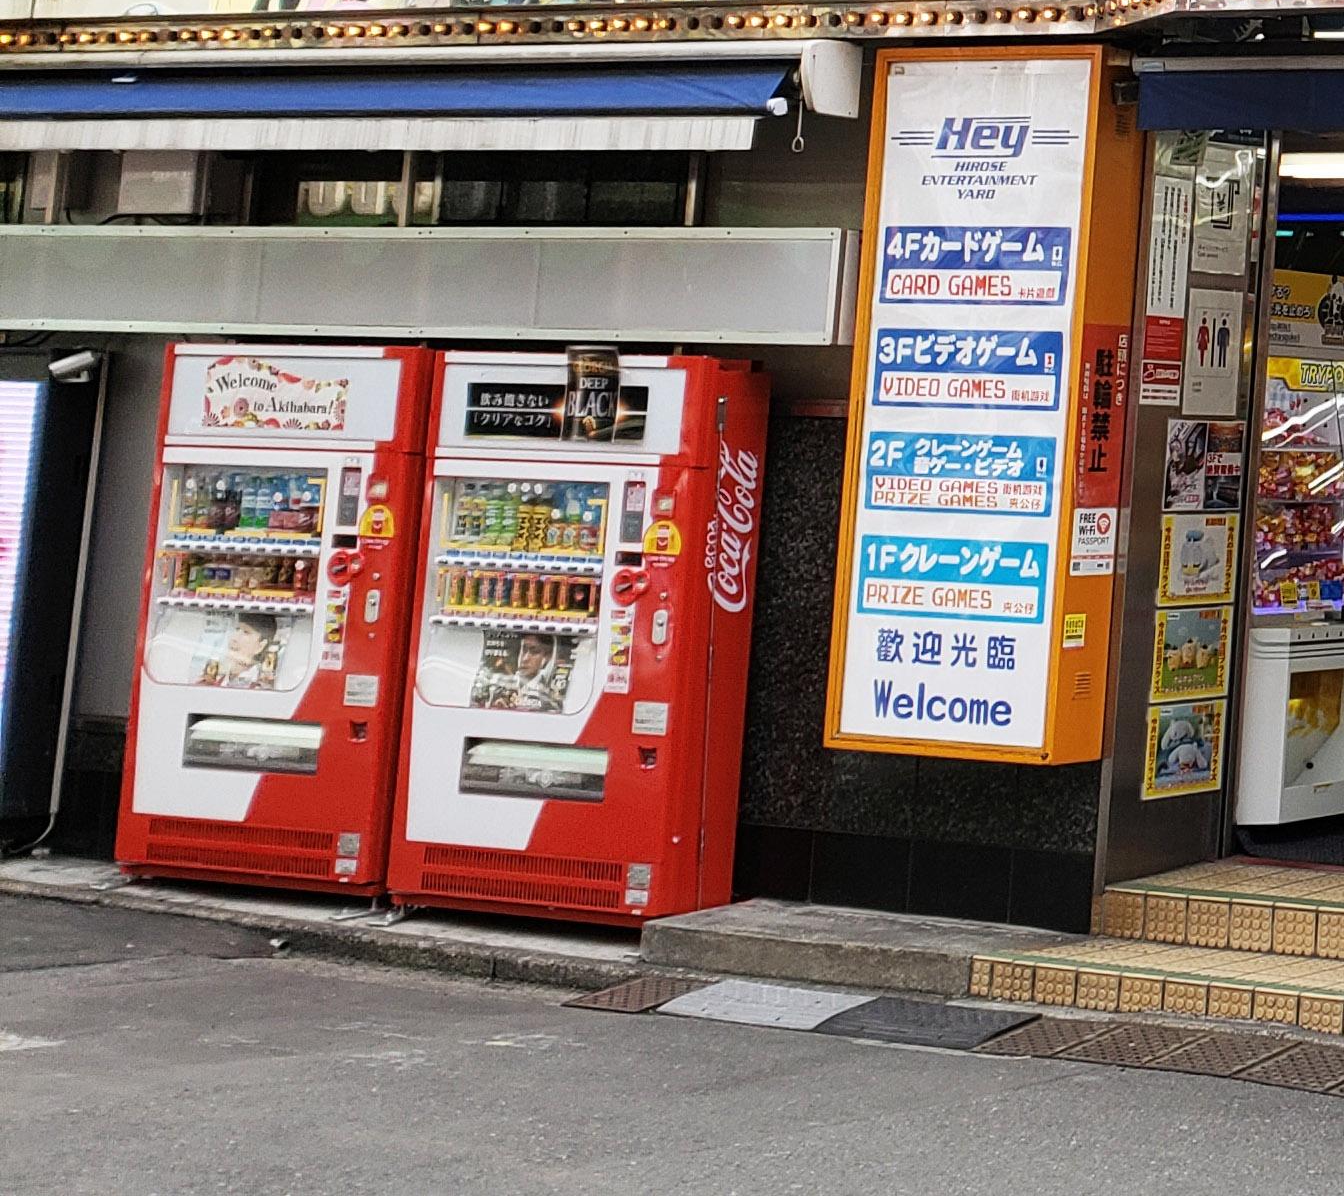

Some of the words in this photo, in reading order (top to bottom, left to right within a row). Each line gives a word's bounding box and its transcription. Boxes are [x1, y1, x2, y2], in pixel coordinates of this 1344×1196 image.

[931, 116, 1032, 158] Hey
[955, 161, 1008, 172] HIROSE
[921, 174, 1038, 187] ENTERTAINMENT
[957, 188, 996, 200] YARD
[887, 230, 1045, 262] 4Fカードゲーム
[890, 274, 940, 295] CARD
[948, 275, 1012, 297] GAMES
[879, 334, 1038, 366] 3Fビデオゲーム
[215, 372, 277, 393] Welcome
[579, 377, 609, 389] DEEP
[883, 377, 940, 397] VIDEO
[947, 379, 1006, 399] GAMES
[254, 401, 264, 412] to
[265, 397, 334, 415] Akihabara!
[567, 390, 619, 418] BLACK
[1088, 348, 1114, 473] 駐輪禁止
[870, 440, 905, 467] 2F
[915, 438, 1022, 458] クレーンゲーム
[875, 477, 932, 492] VIDEO
[939, 479, 998, 495] GAMES
[874, 491, 930, 505] PRIZE
[938, 494, 998, 508] GAMES
[1079, 513, 1096, 524] FREE
[1077, 536, 1109, 545] PASSPORT
[868, 543, 1040, 578] 1Fクレーンゲーム
[866, 584, 925, 606] PRIZE
[932, 587, 993, 610] GAMES
[876, 627, 1017, 671] 歡迎光臨
[873, 678, 1013, 727] Welcome
